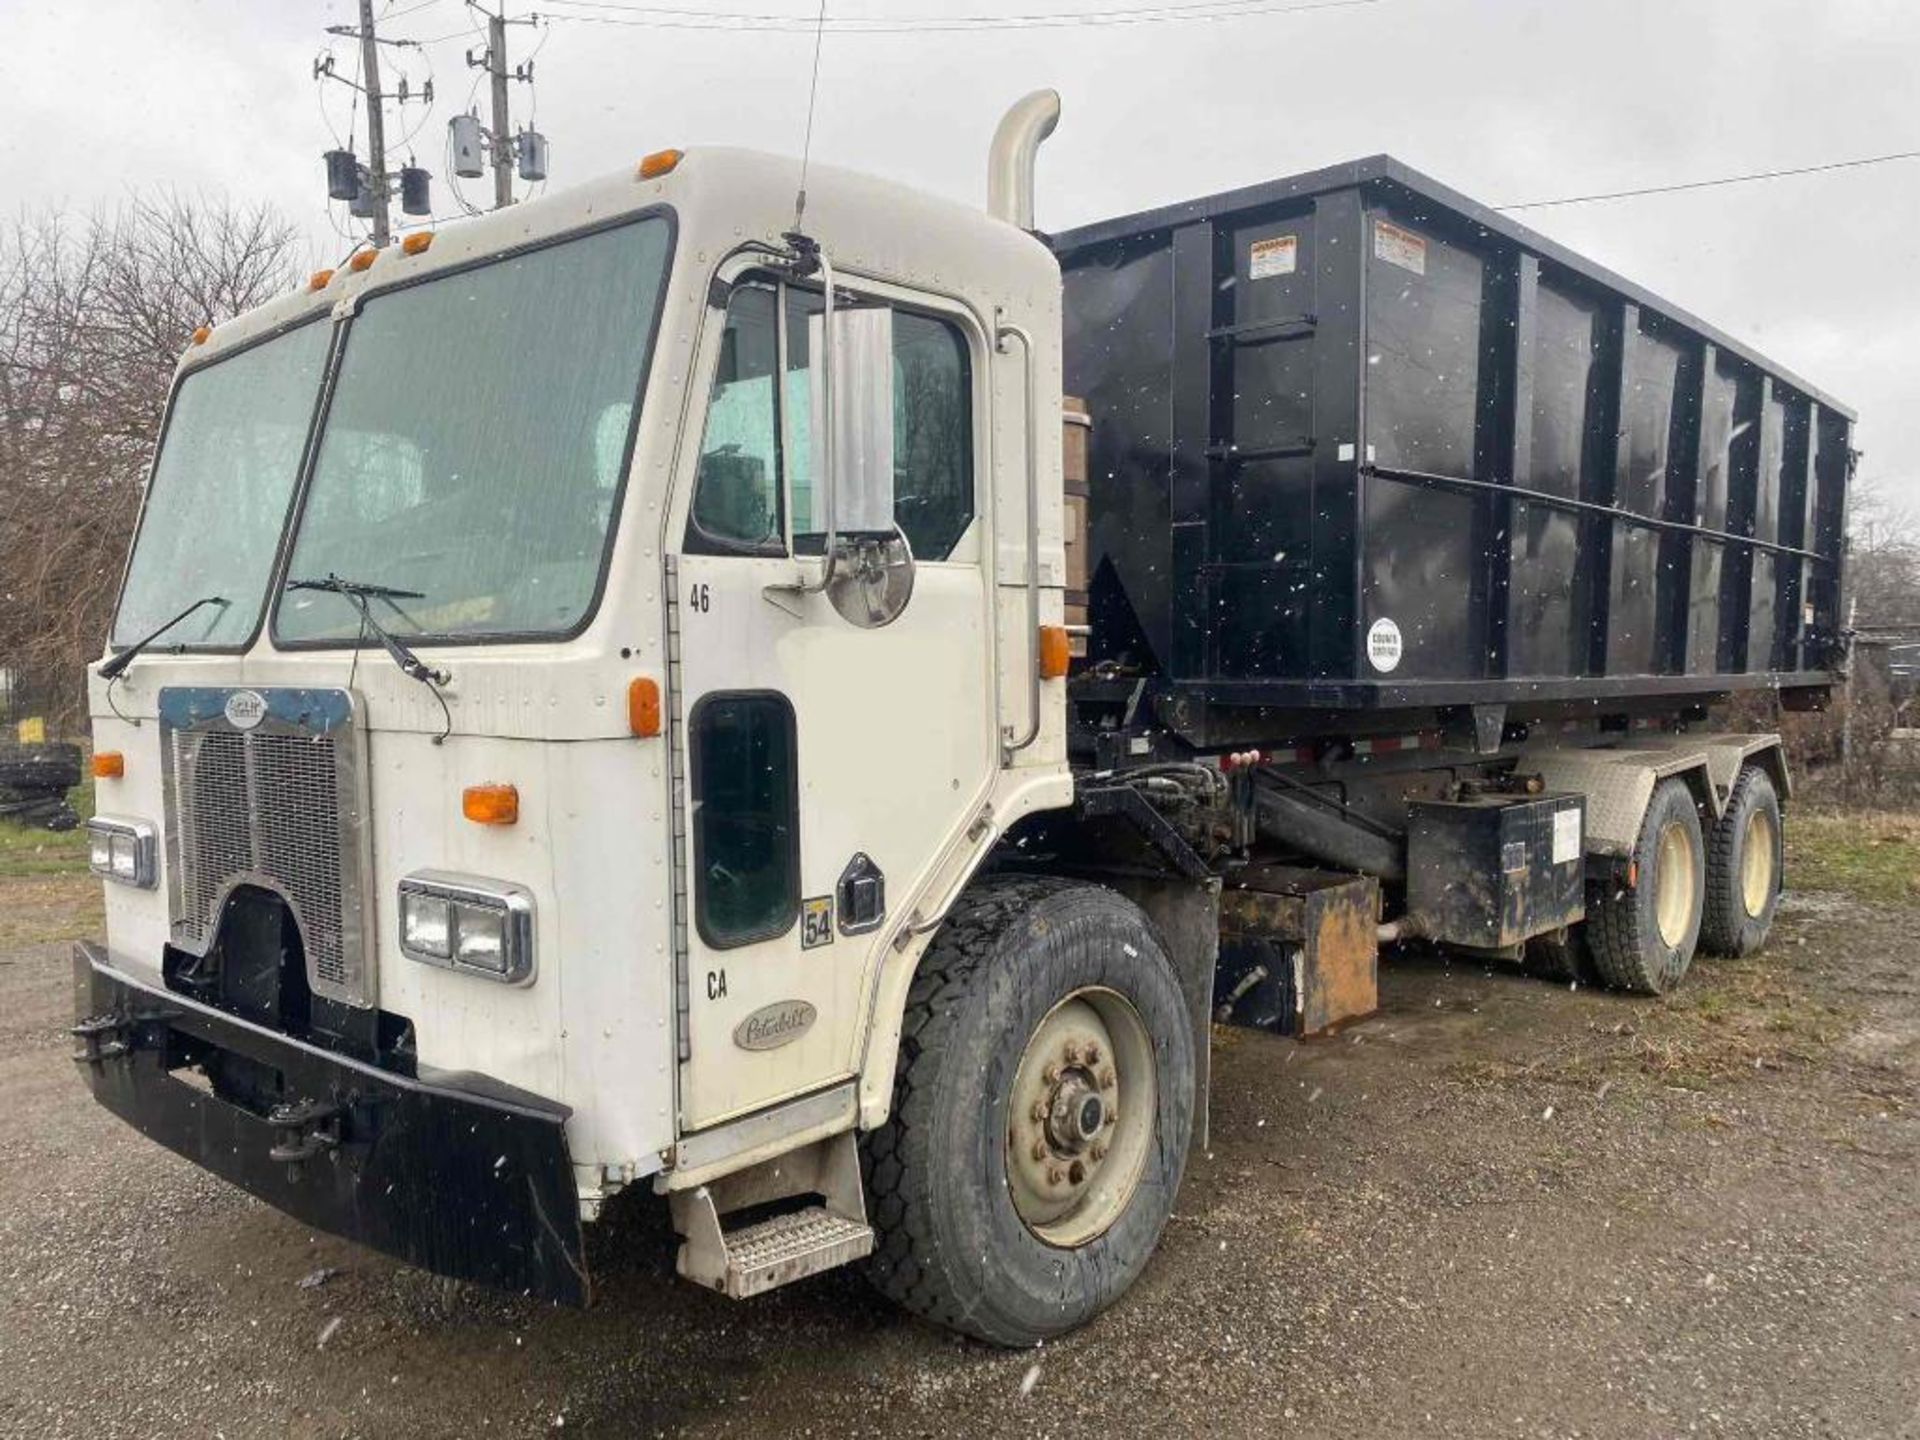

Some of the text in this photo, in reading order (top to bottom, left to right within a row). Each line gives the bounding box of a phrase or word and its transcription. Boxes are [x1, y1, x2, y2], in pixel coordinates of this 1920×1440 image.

[690, 583, 709, 613] 46
[805, 910, 830, 944] 54
[707, 968, 727, 1000] CA
